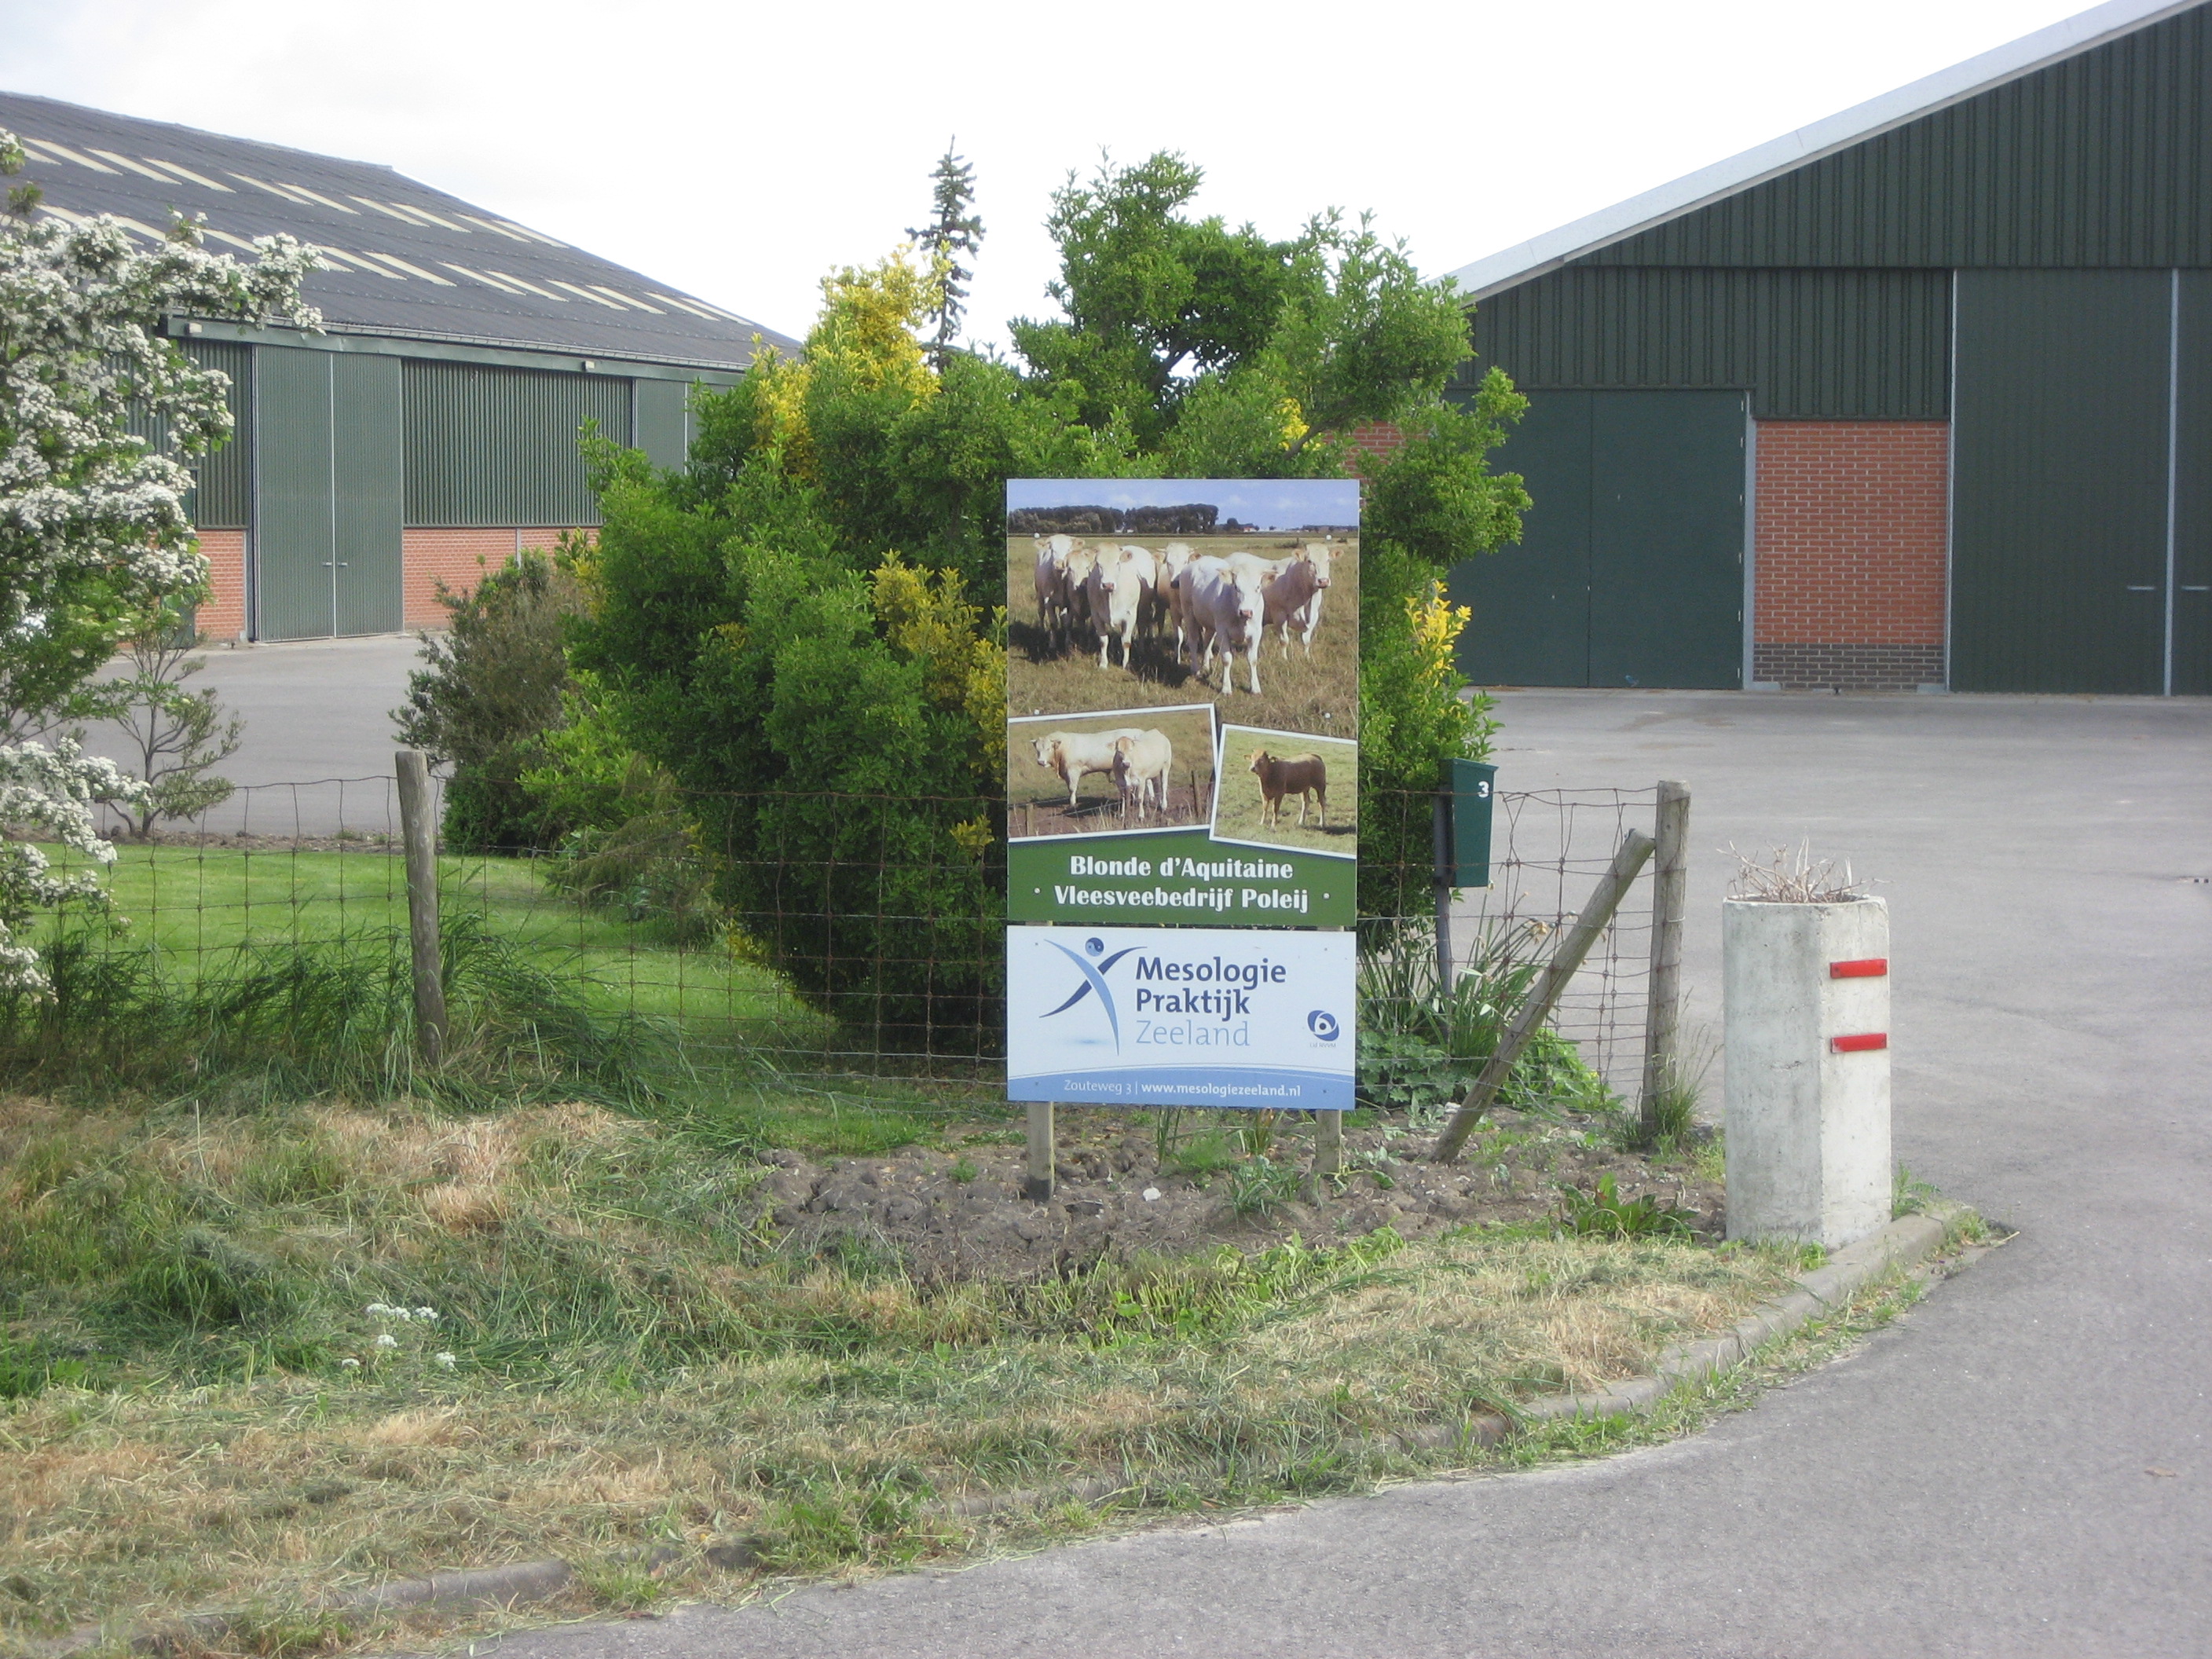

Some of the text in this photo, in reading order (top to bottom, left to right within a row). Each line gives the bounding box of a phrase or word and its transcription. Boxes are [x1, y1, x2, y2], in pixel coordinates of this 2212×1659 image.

[1478, 781, 1489, 798] 3
[1070, 855, 1294, 881] Blonde d’Aquitaine
[1054, 885, 1309, 914] Vleesveebedrijf Poleij
[1136, 957, 1287, 990] Mesologie
[1136, 988, 1251, 1021] Praktijk
[1136, 1020, 1251, 1046] Zeeland
[1064, 1079, 1301, 1097] Zouteweg 3 www.mesologiezeeland.nl
